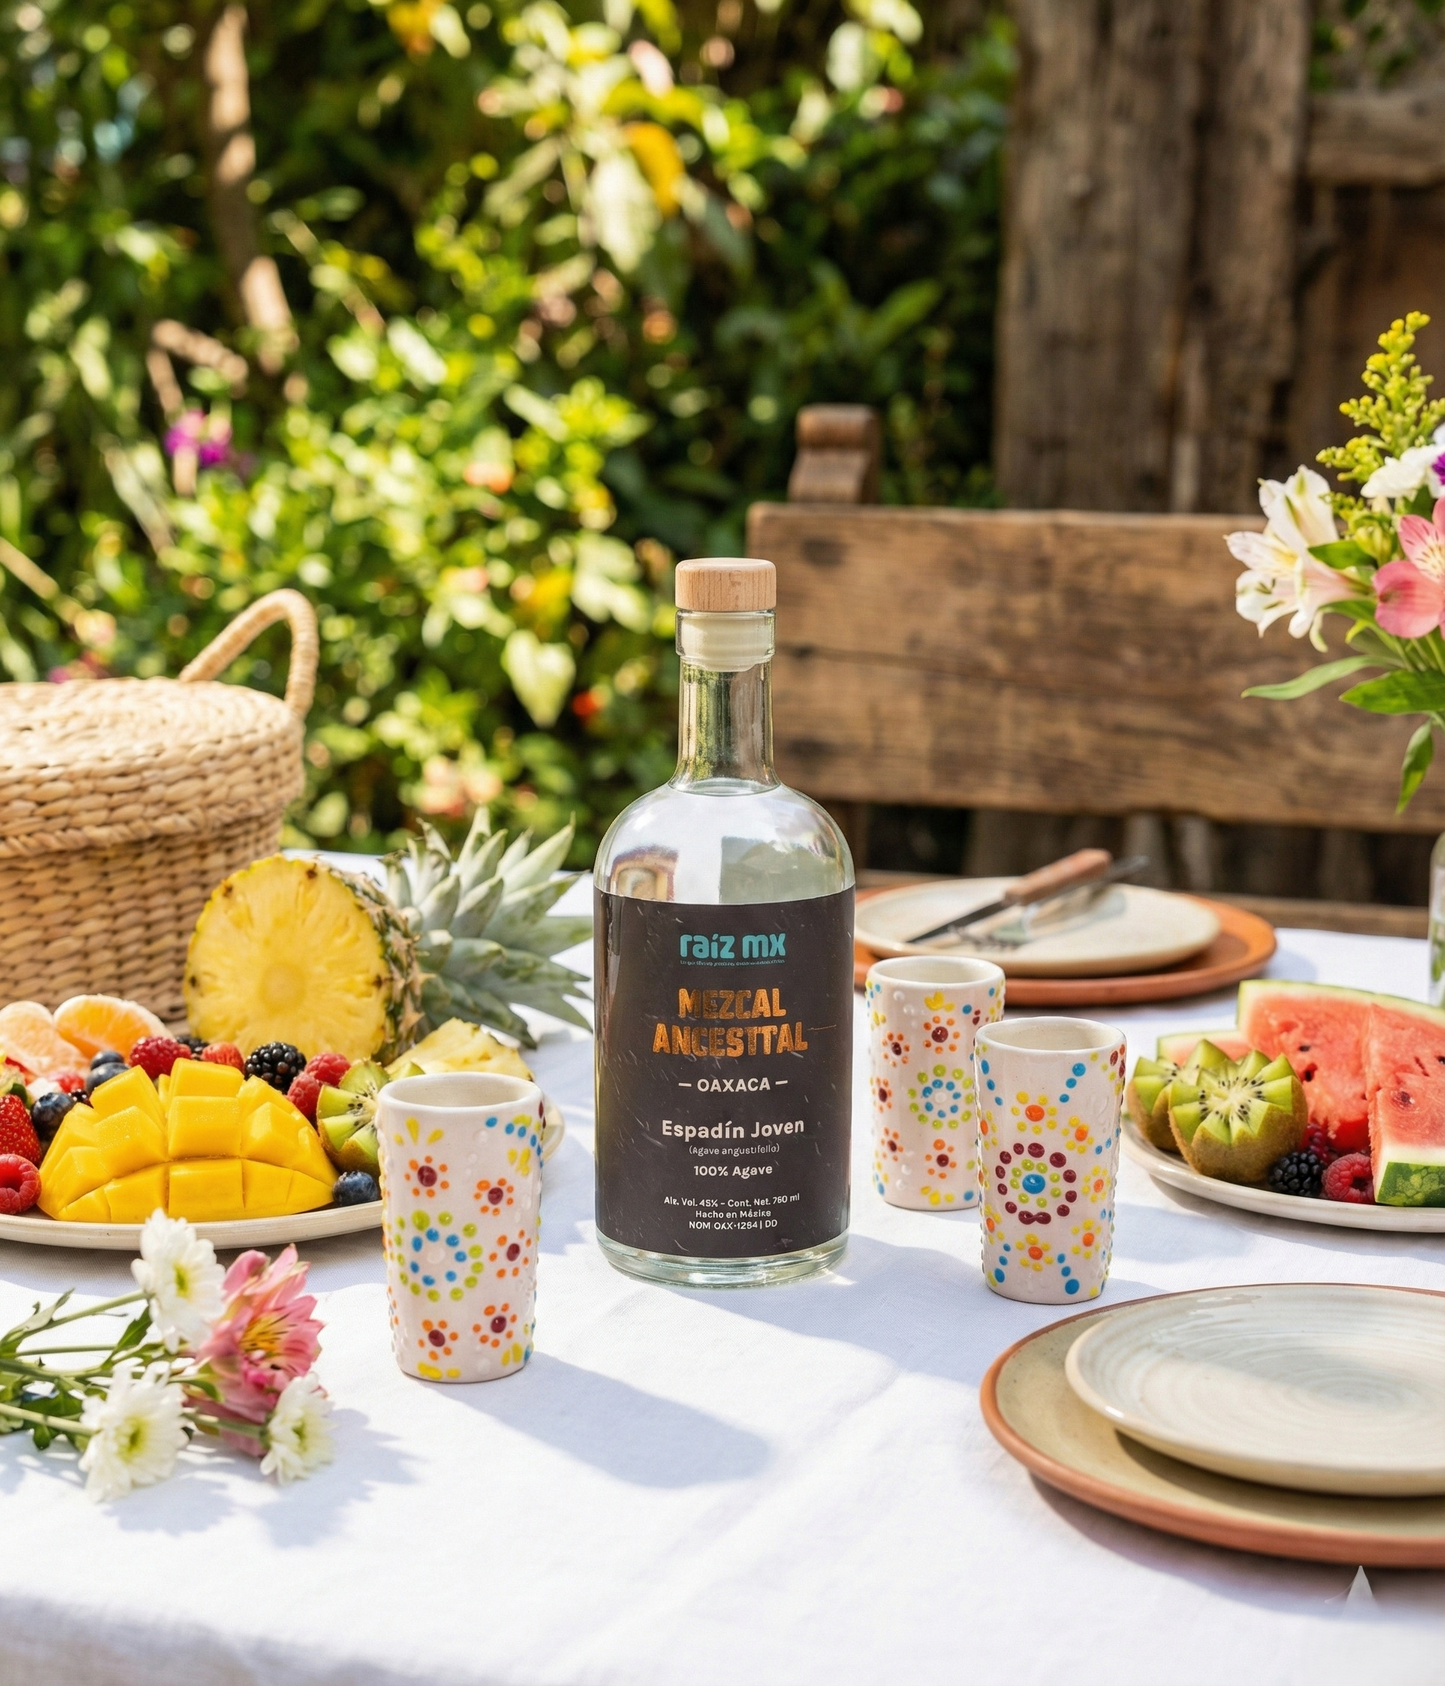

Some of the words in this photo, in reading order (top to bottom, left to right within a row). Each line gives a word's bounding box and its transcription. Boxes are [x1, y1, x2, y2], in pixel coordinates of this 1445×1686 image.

[680, 933, 735, 959] raíz
[742, 933, 786, 959] mx
[678, 988, 787, 1019] MEZCAL
[652, 1021, 809, 1058] ANCESTTAL
[697, 1077, 771, 1093] OAXACA
[662, 1119, 745, 1142] Espadín
[750, 1119, 805, 1138] Joven
[693, 1165, 729, 1177] 100%
[732, 1165, 773, 1179] Agave
[681, 1197, 698, 1207] Vol.
[727, 1199, 752, 1208] Cont.
[753, 1197, 771, 1207] Net.
[789, 1193, 800, 1203] ml
[726, 1211, 738, 1219] en
[688, 1221, 711, 1230] NOM
